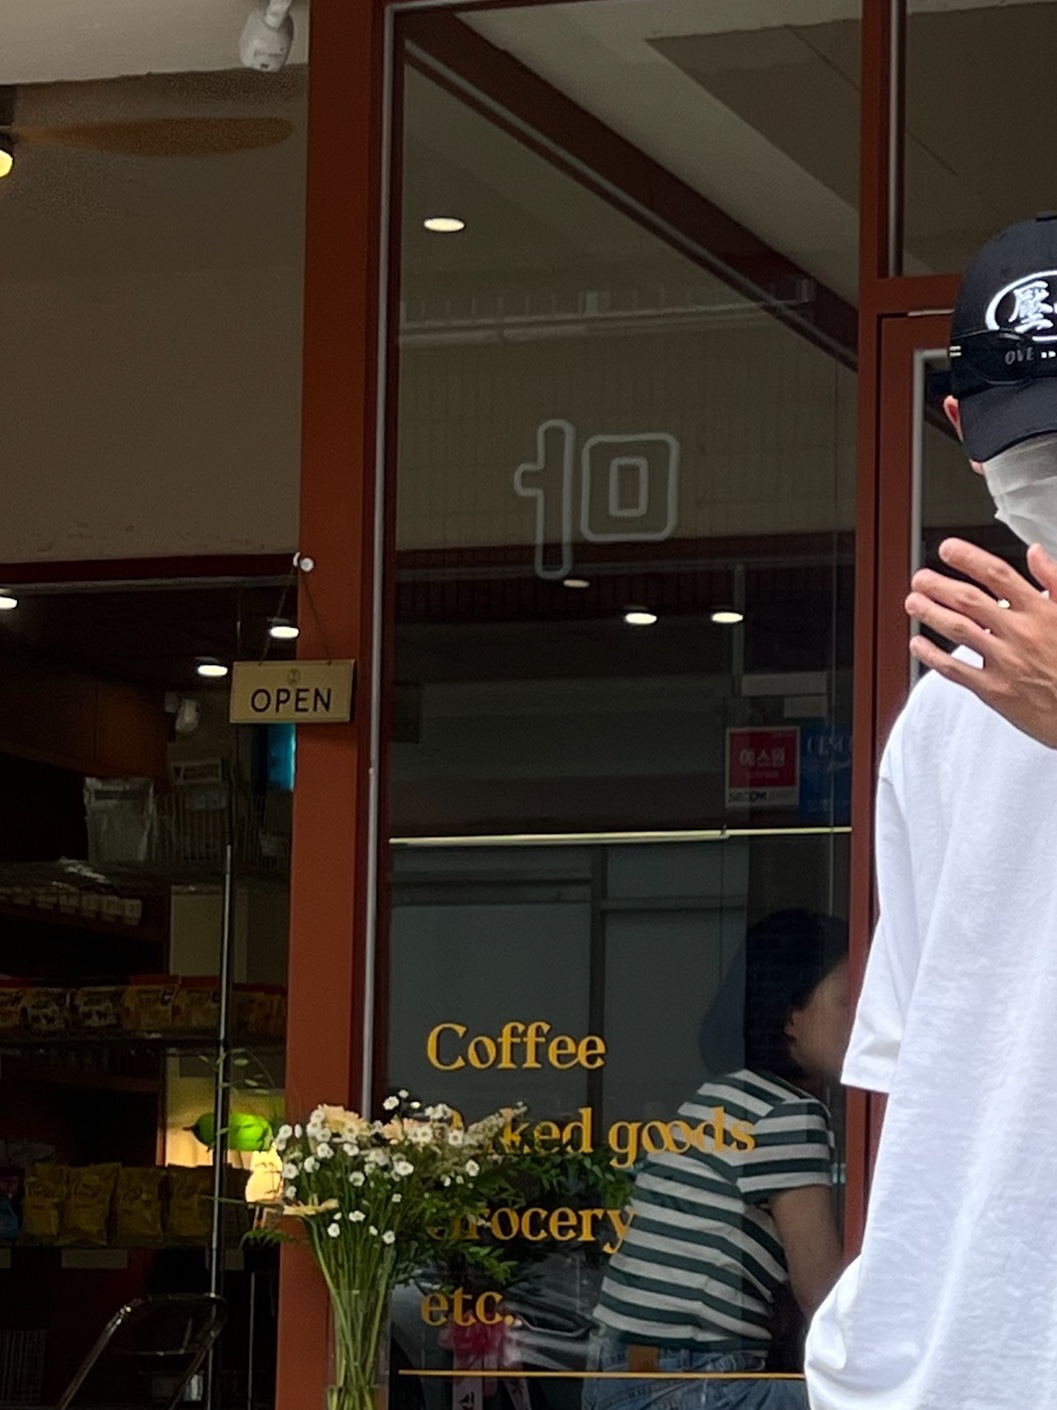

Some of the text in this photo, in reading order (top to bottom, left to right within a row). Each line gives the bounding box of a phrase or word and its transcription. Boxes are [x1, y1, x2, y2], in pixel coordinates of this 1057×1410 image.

[250, 687, 332, 713] OPEN
[427, 1021, 607, 1070] Coffee
[608, 1105, 757, 1168] goods
[420, 1286, 516, 1327] etc.
